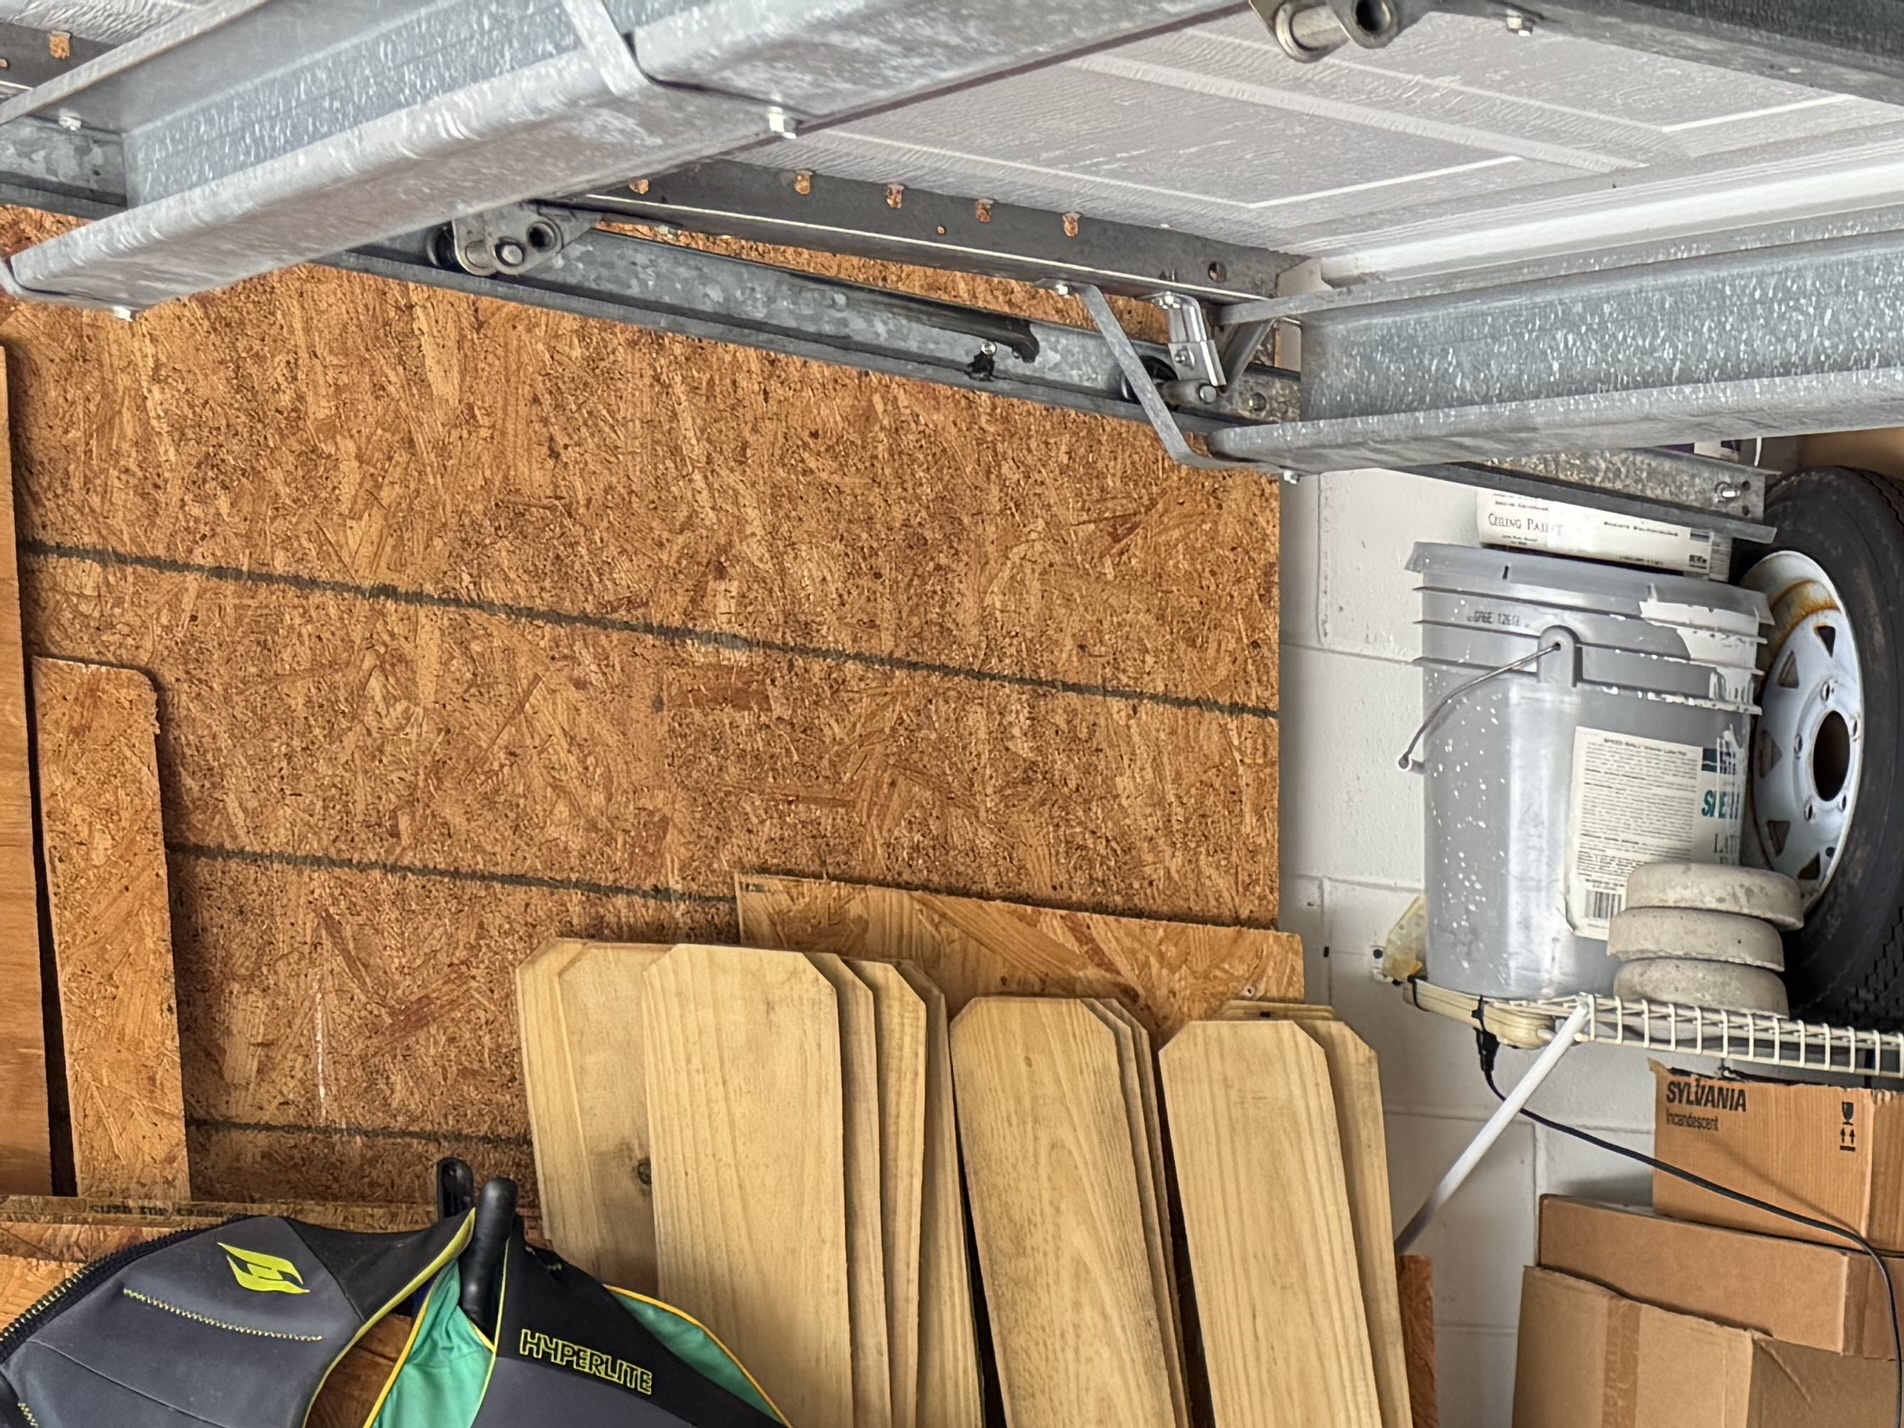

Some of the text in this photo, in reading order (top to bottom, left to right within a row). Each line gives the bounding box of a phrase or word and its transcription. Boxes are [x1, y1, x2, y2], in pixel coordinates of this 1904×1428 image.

[1665, 1081, 1747, 1113] SYLVANIA
[1665, 1111, 1719, 1132] Incandescent
[519, 1328, 655, 1395] HYPERLITE
